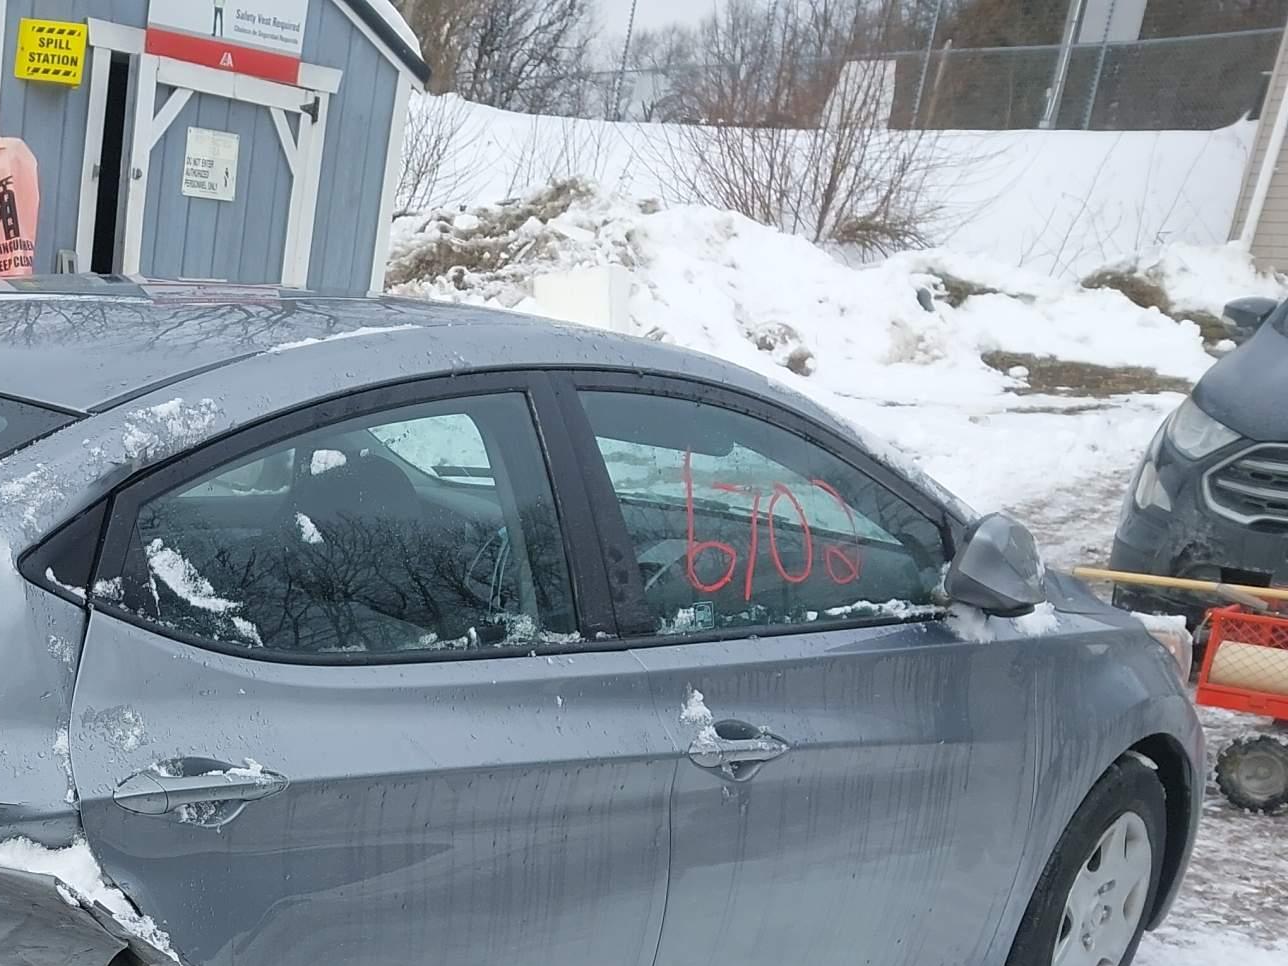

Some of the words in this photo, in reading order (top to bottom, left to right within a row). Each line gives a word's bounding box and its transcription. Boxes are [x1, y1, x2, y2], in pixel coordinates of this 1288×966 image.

[236, 9, 256, 24] Safety
[257, 12, 272, 26] Vest
[272, 17, 300, 32] Required
[38, 36, 72, 50] SPILL
[28, 51, 78, 67] STATION
[13, 255, 33, 268] CLEA
